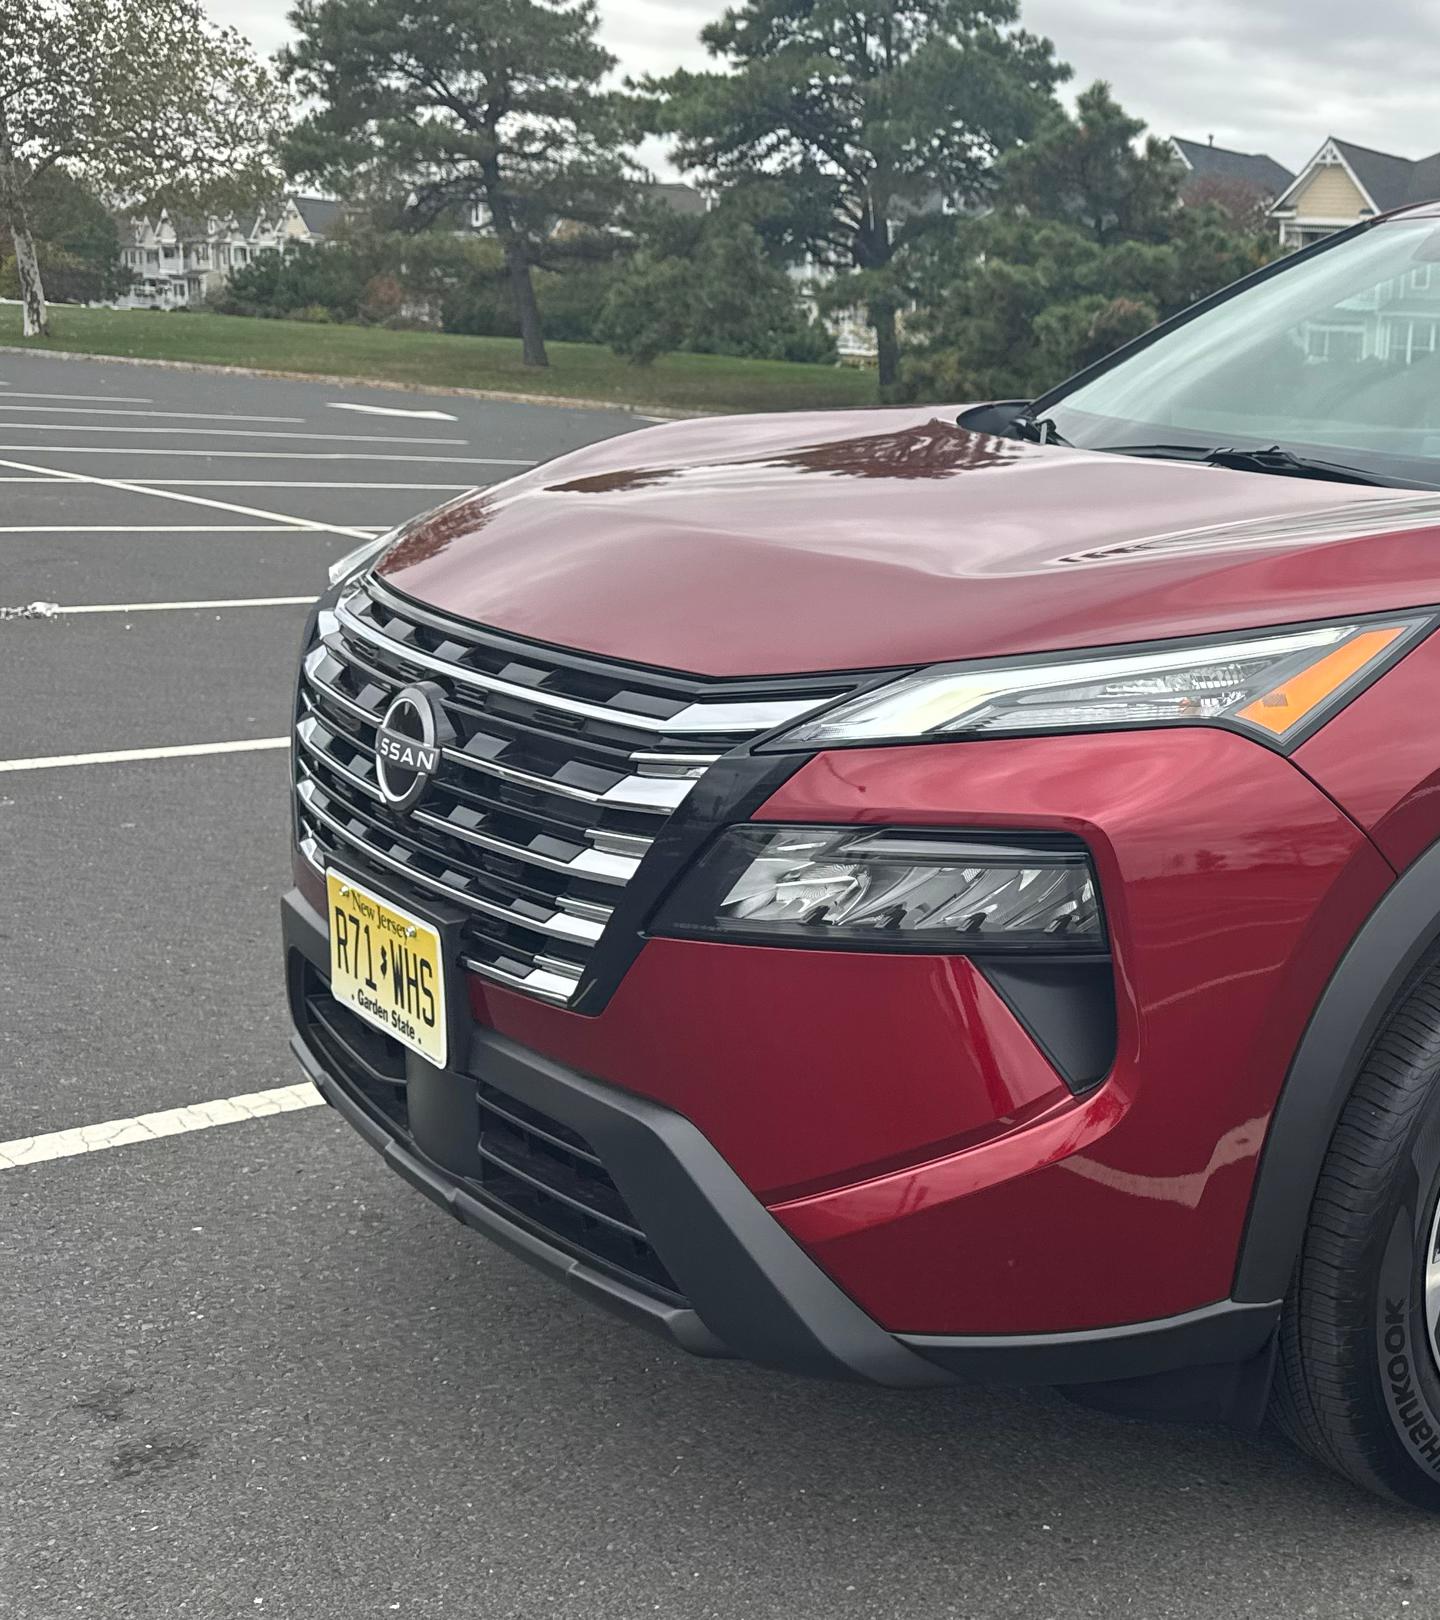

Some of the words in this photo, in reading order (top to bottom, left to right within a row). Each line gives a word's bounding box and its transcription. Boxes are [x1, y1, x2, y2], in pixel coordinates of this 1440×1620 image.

[351, 889, 375, 921] New
[376, 904, 411, 945] Jersey
[335, 905, 377, 992] R71
[389, 939, 435, 1029] WHS
[357, 988, 388, 1023] Garden
[391, 1010, 416, 1040] State
